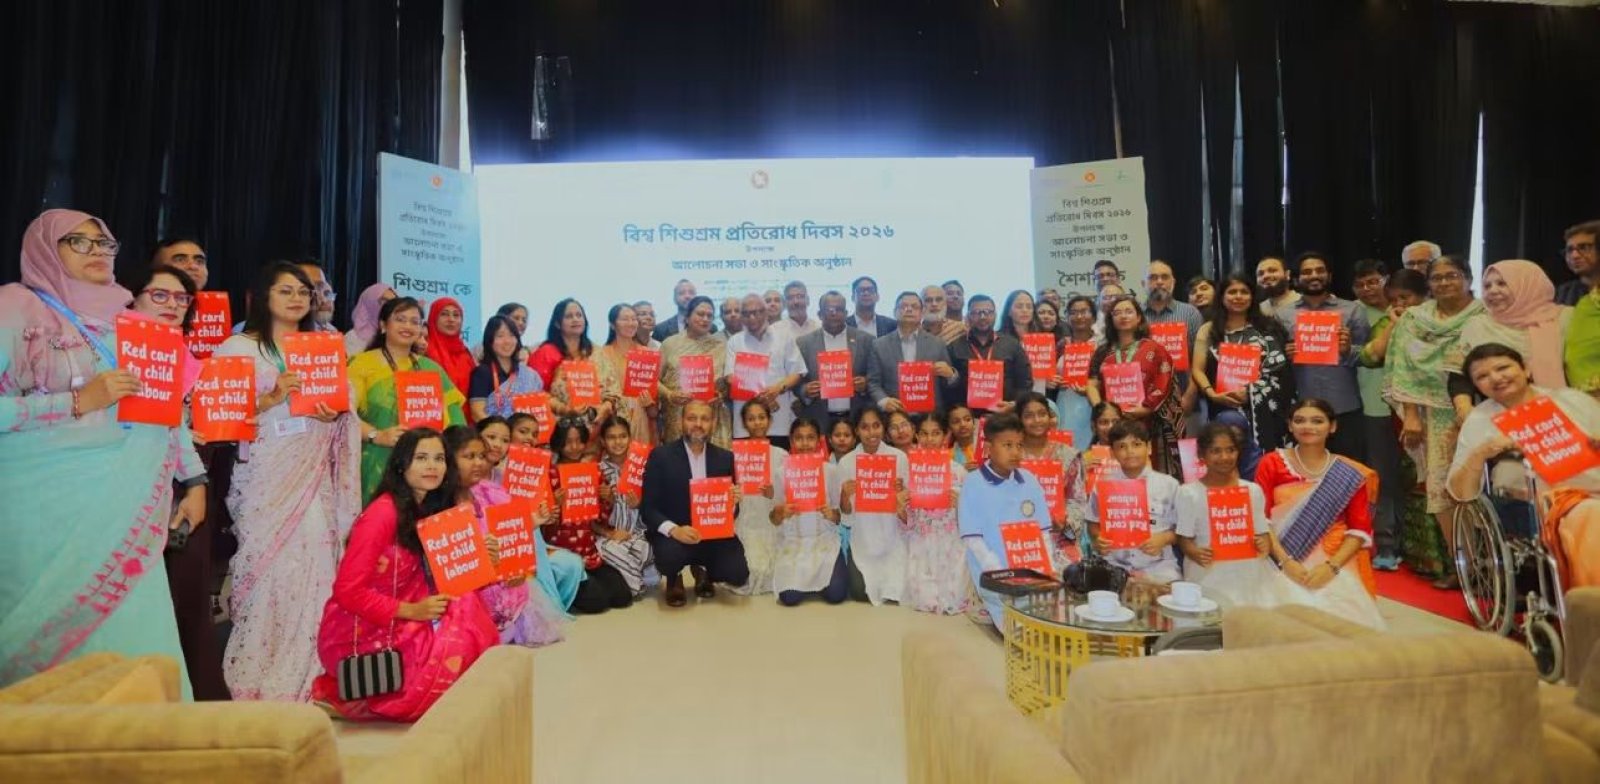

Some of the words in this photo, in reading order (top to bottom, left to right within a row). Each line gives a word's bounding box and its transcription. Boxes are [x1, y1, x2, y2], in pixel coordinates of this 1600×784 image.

[624, 224, 654, 242] বিশ্ব
[659, 223, 720, 242] শিশুশ্রম
[726, 221, 796, 241] প্রতিরোধ
[802, 220, 843, 239] দিবস
[849, 224, 894, 238] ২০২৬
[672, 259, 722, 270] আলোচনা
[726, 259, 746, 269] সভা
[750, 260, 758, 268] ও
[393, 272, 449, 294] শিশুশ্রম
[453, 284, 472, 296] কে
[202, 310, 224, 322] card
[198, 324, 224, 336] child
[122, 340, 147, 357] Red
[151, 348, 177, 364] card
[290, 354, 311, 366] Red
[314, 352, 339, 364] card
[144, 366, 174, 382] child
[296, 368, 307, 379] to
[310, 367, 338, 379] child
[196, 376, 219, 392] Red
[223, 376, 249, 389] card
[301, 382, 338, 396] labour
[405, 386, 434, 394] labour
[137, 382, 172, 401] bour
[199, 394, 214, 406] to
[218, 392, 248, 406] child
[406, 398, 426, 409] child
[430, 398, 438, 406] to
[207, 408, 247, 422] labour
[405, 411, 424, 422] card
[427, 411, 442, 420] Red
[1509, 425, 1535, 441] Red
[1535, 413, 1564, 433] card
[1524, 442, 1540, 454] to
[1541, 428, 1571, 447] child
[1538, 442, 1582, 465] labour
[508, 459, 524, 472] Red
[525, 464, 544, 474] card
[508, 473, 517, 483] to
[519, 476, 539, 486] child
[568, 475, 592, 484] labour
[509, 484, 536, 498] labour
[568, 487, 585, 498] child
[587, 486, 595, 494] to
[566, 499, 582, 508] card
[584, 497, 597, 506] Red
[693, 494, 708, 503] Red
[710, 492, 728, 502] card
[1108, 495, 1138, 507] labour
[696, 506, 706, 514] to
[707, 503, 726, 513] child
[1107, 508, 1130, 519] child
[1133, 509, 1143, 517] to
[1212, 507, 1227, 517] Red
[1229, 504, 1248, 515] card
[496, 518, 524, 530] labour
[700, 516, 725, 526] labour
[1105, 521, 1126, 532] card
[1130, 520, 1147, 531] Red
[1216, 520, 1225, 530] to
[1227, 518, 1247, 530] child
[426, 536, 448, 553] Red
[450, 524, 474, 542] card
[498, 534, 518, 546] child
[519, 531, 529, 540] to
[1219, 533, 1247, 544] labour
[435, 554, 448, 566] to
[450, 540, 476, 560] child
[498, 548, 516, 559] card
[518, 544, 533, 556] Red
[444, 558, 480, 581] labour
